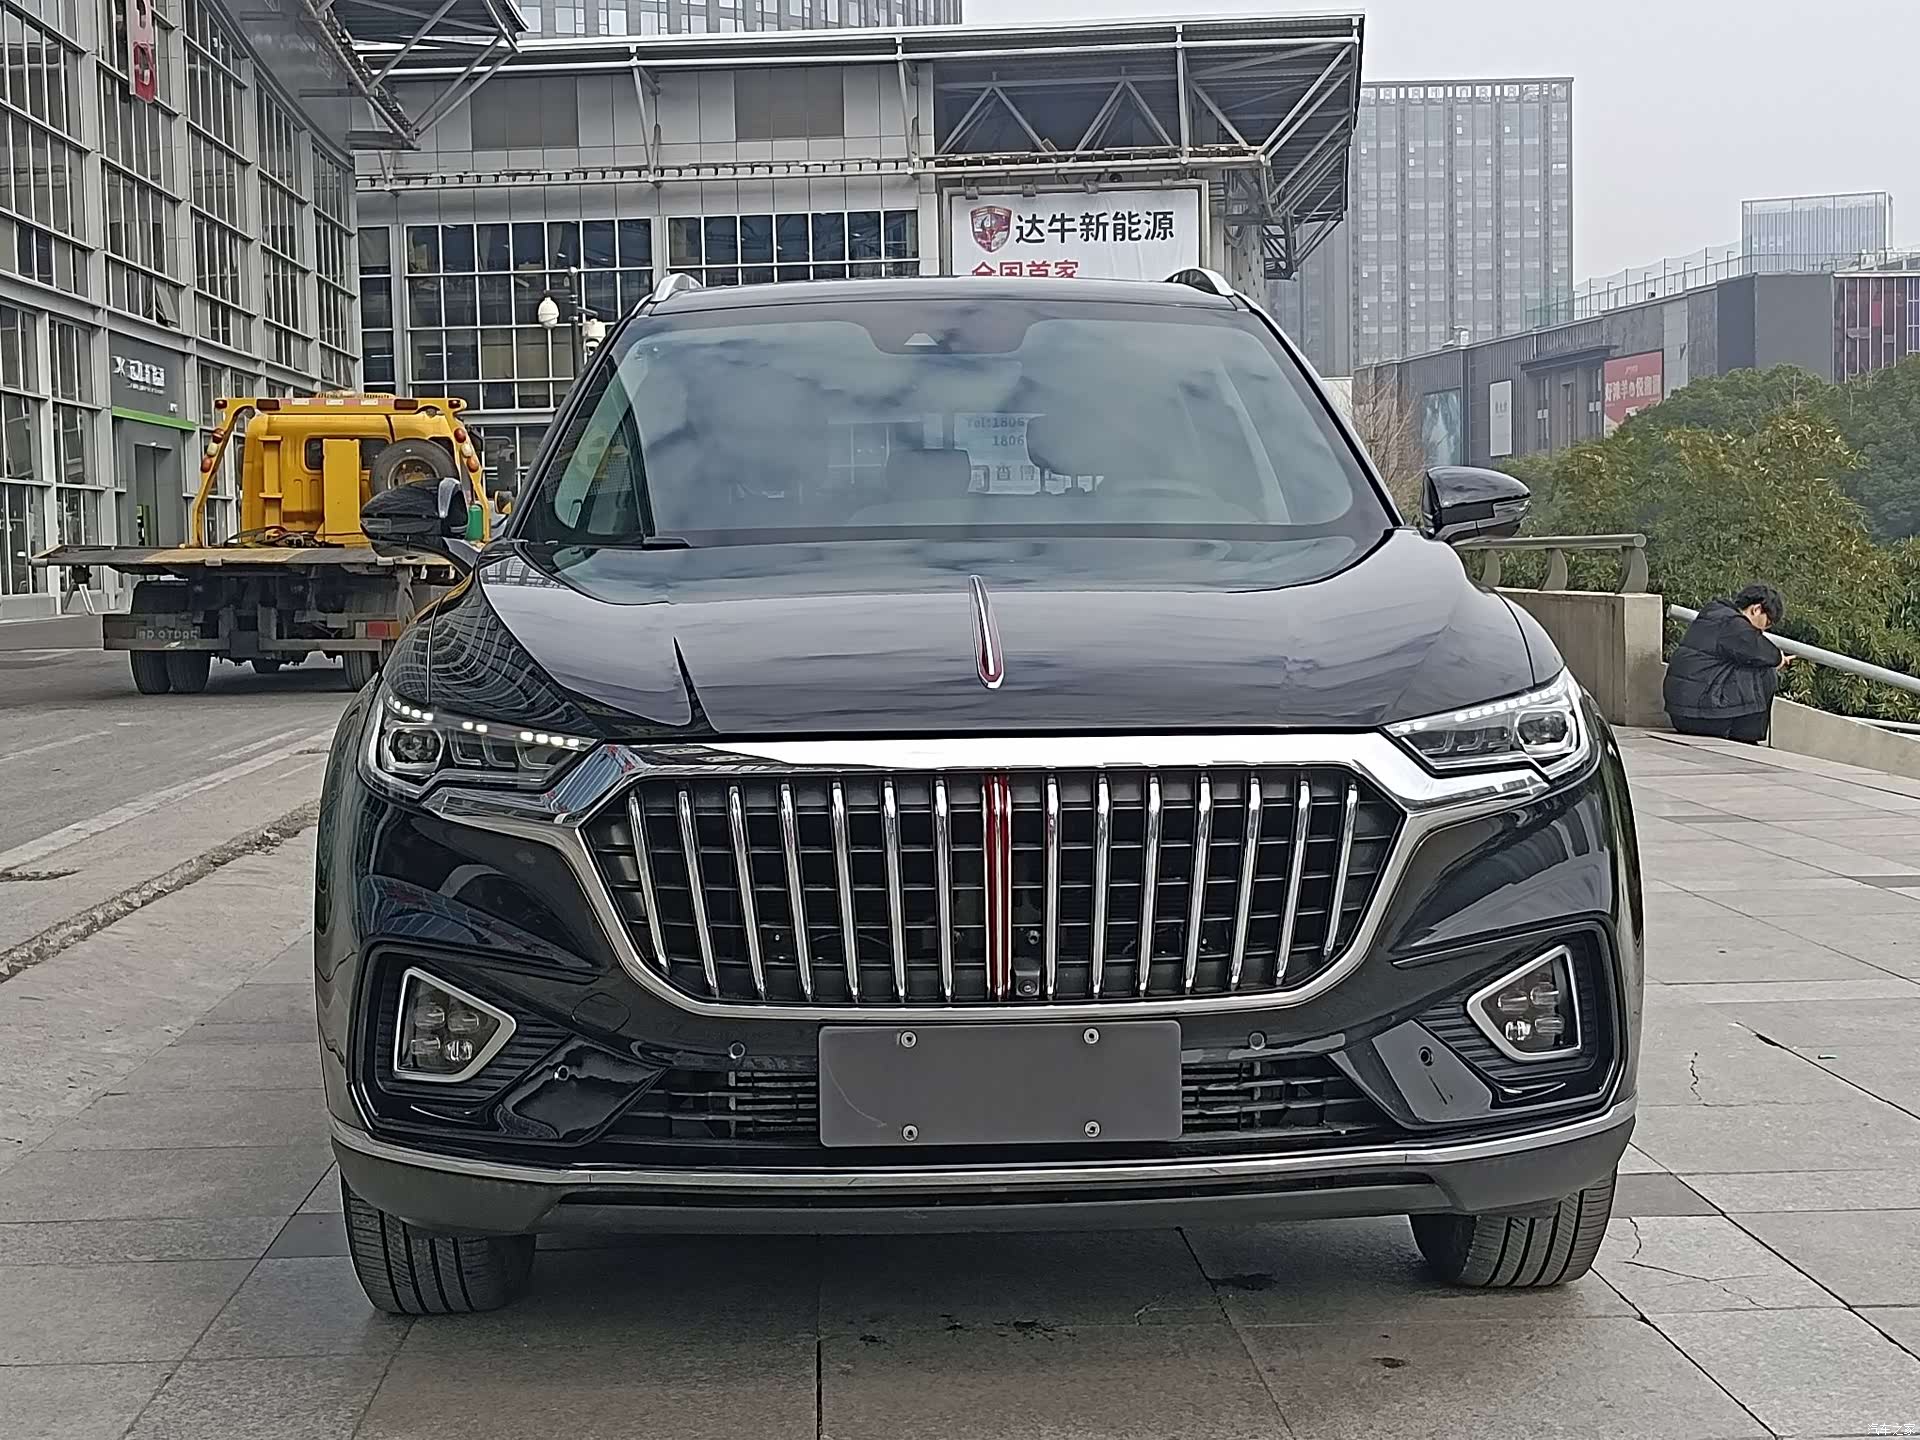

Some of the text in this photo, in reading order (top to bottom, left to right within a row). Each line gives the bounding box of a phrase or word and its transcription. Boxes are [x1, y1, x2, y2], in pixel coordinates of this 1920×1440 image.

[1015, 210, 1175, 244] 达牛新能源
[967, 416, 1027, 429] Tel:1806
